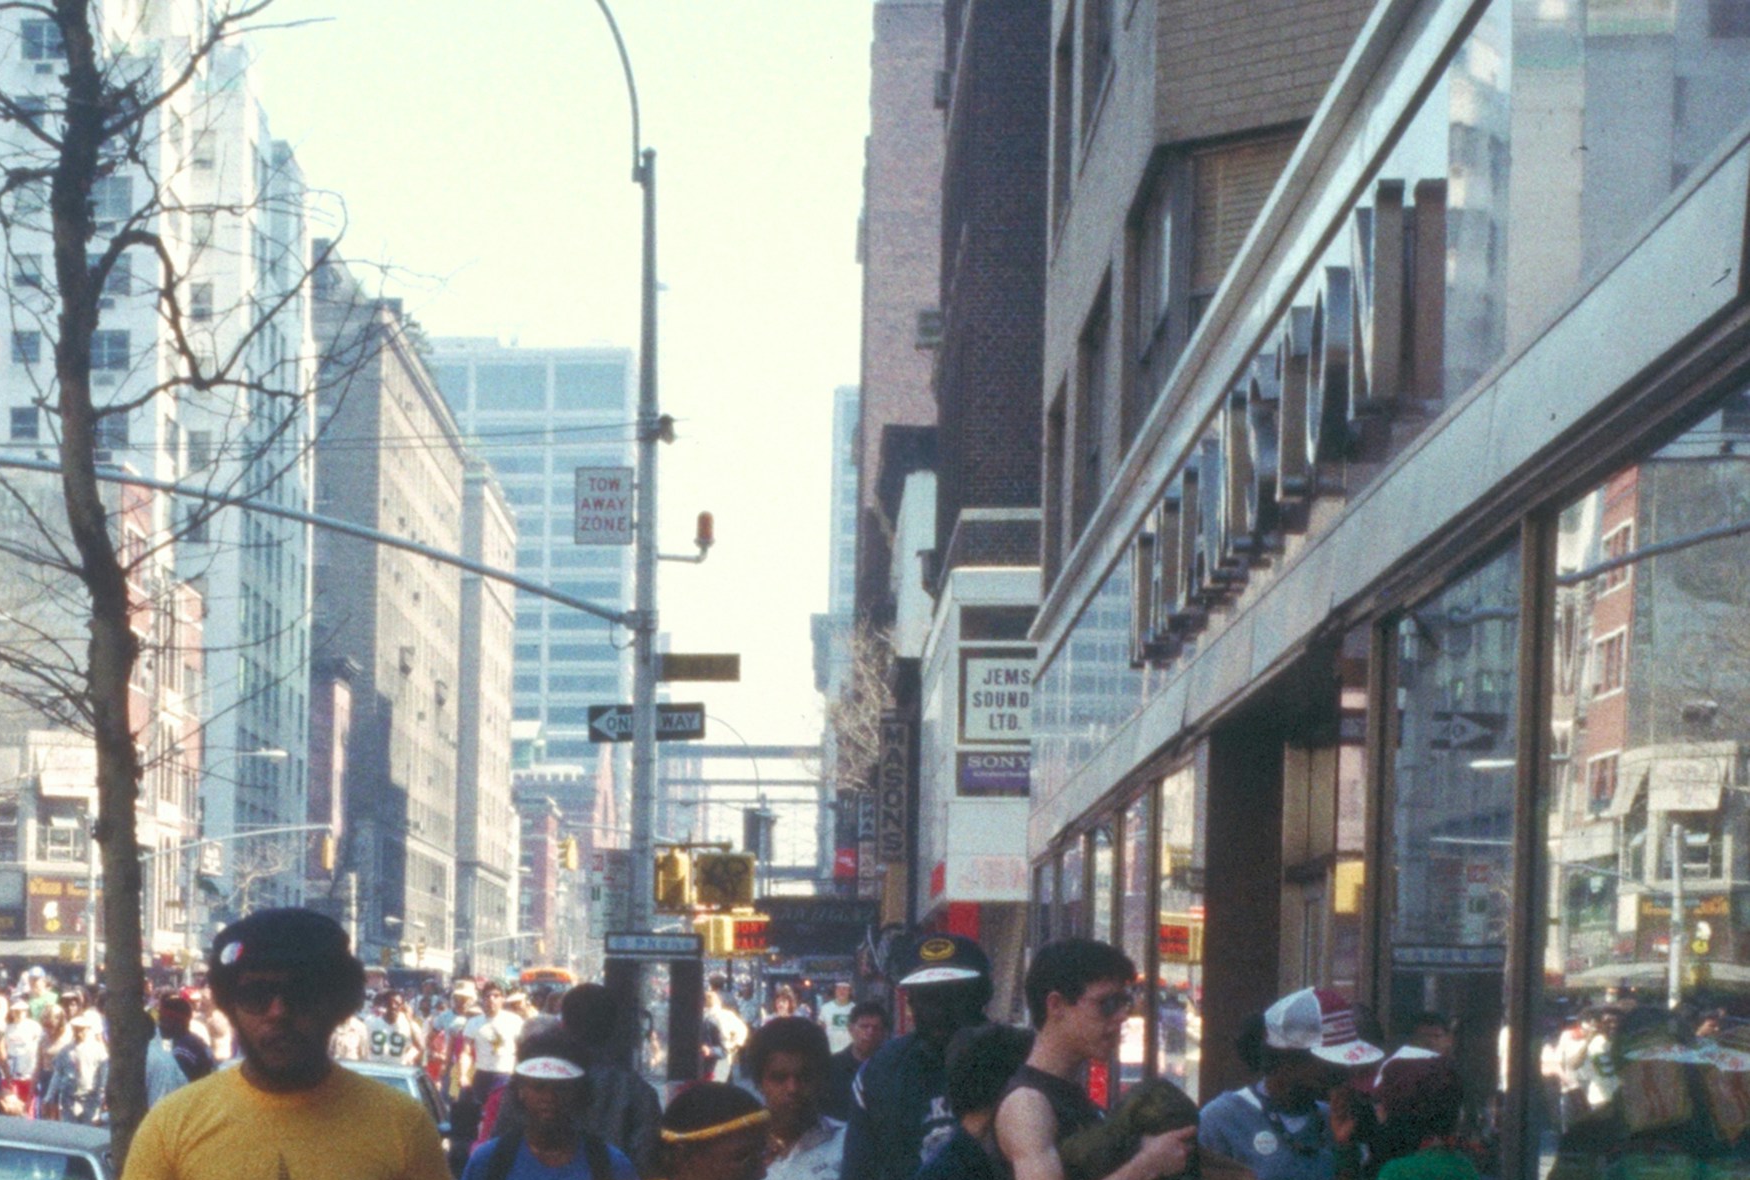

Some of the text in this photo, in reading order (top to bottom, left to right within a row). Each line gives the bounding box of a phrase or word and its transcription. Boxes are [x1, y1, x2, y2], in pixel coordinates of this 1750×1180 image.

[588, 478, 621, 492] TOW
[580, 498, 627, 511] AWAY
[579, 517, 627, 532] ZONE
[982, 668, 1031, 685] JEMS
[972, 691, 1030, 708] SOUND
[606, 713, 696, 732] ON WAY
[989, 713, 1022, 731] LTD.
[967, 755, 1031, 768] SONY
[370, 1030, 406, 1057] 99
